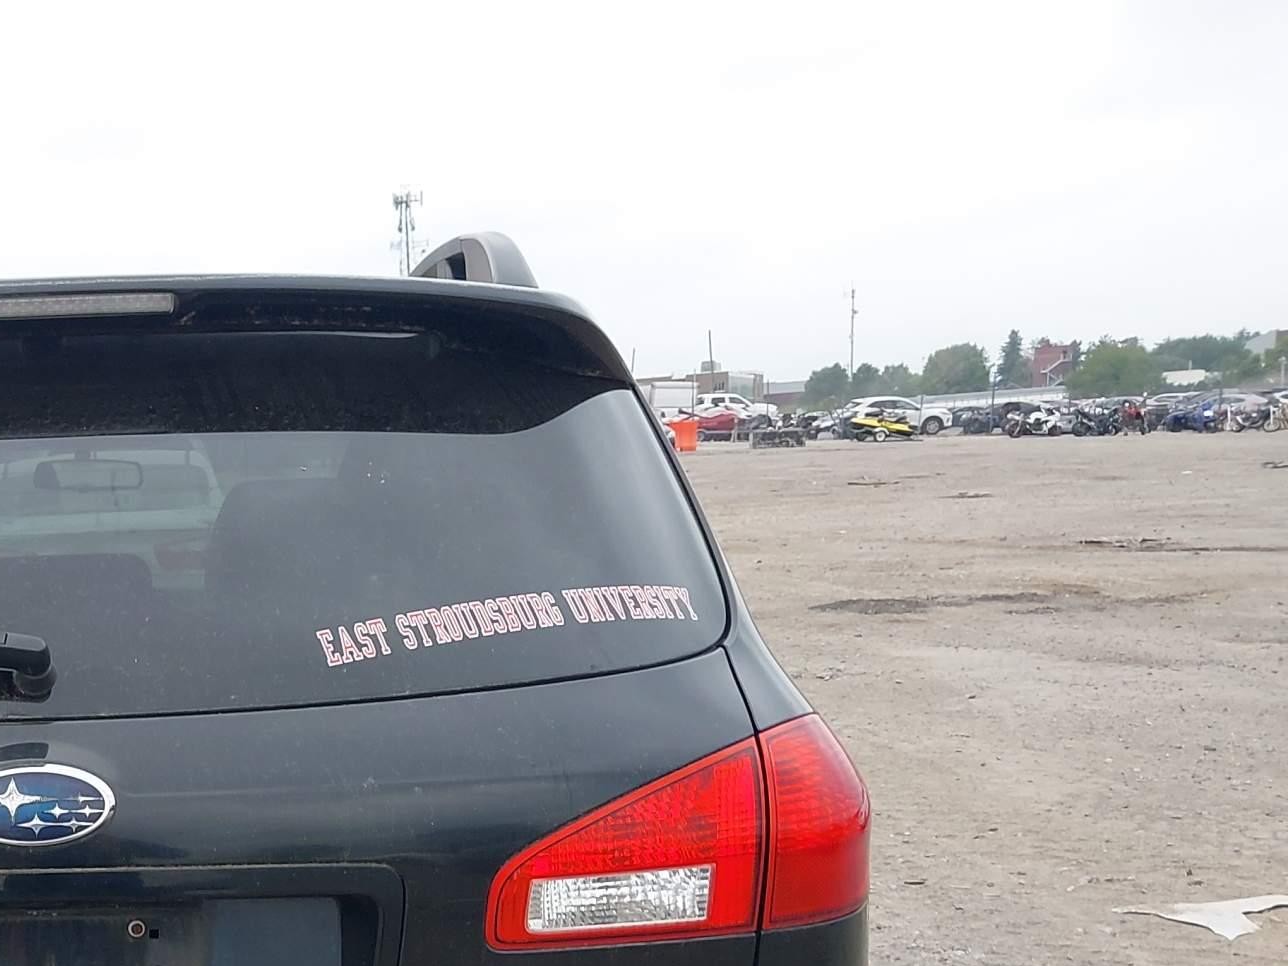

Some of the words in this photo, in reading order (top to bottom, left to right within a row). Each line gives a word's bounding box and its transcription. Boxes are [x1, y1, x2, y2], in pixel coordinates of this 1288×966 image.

[316, 618, 392, 667] EAST
[395, 591, 565, 650] STROUDSBURG
[561, 584, 699, 625] UNIVERSITY
